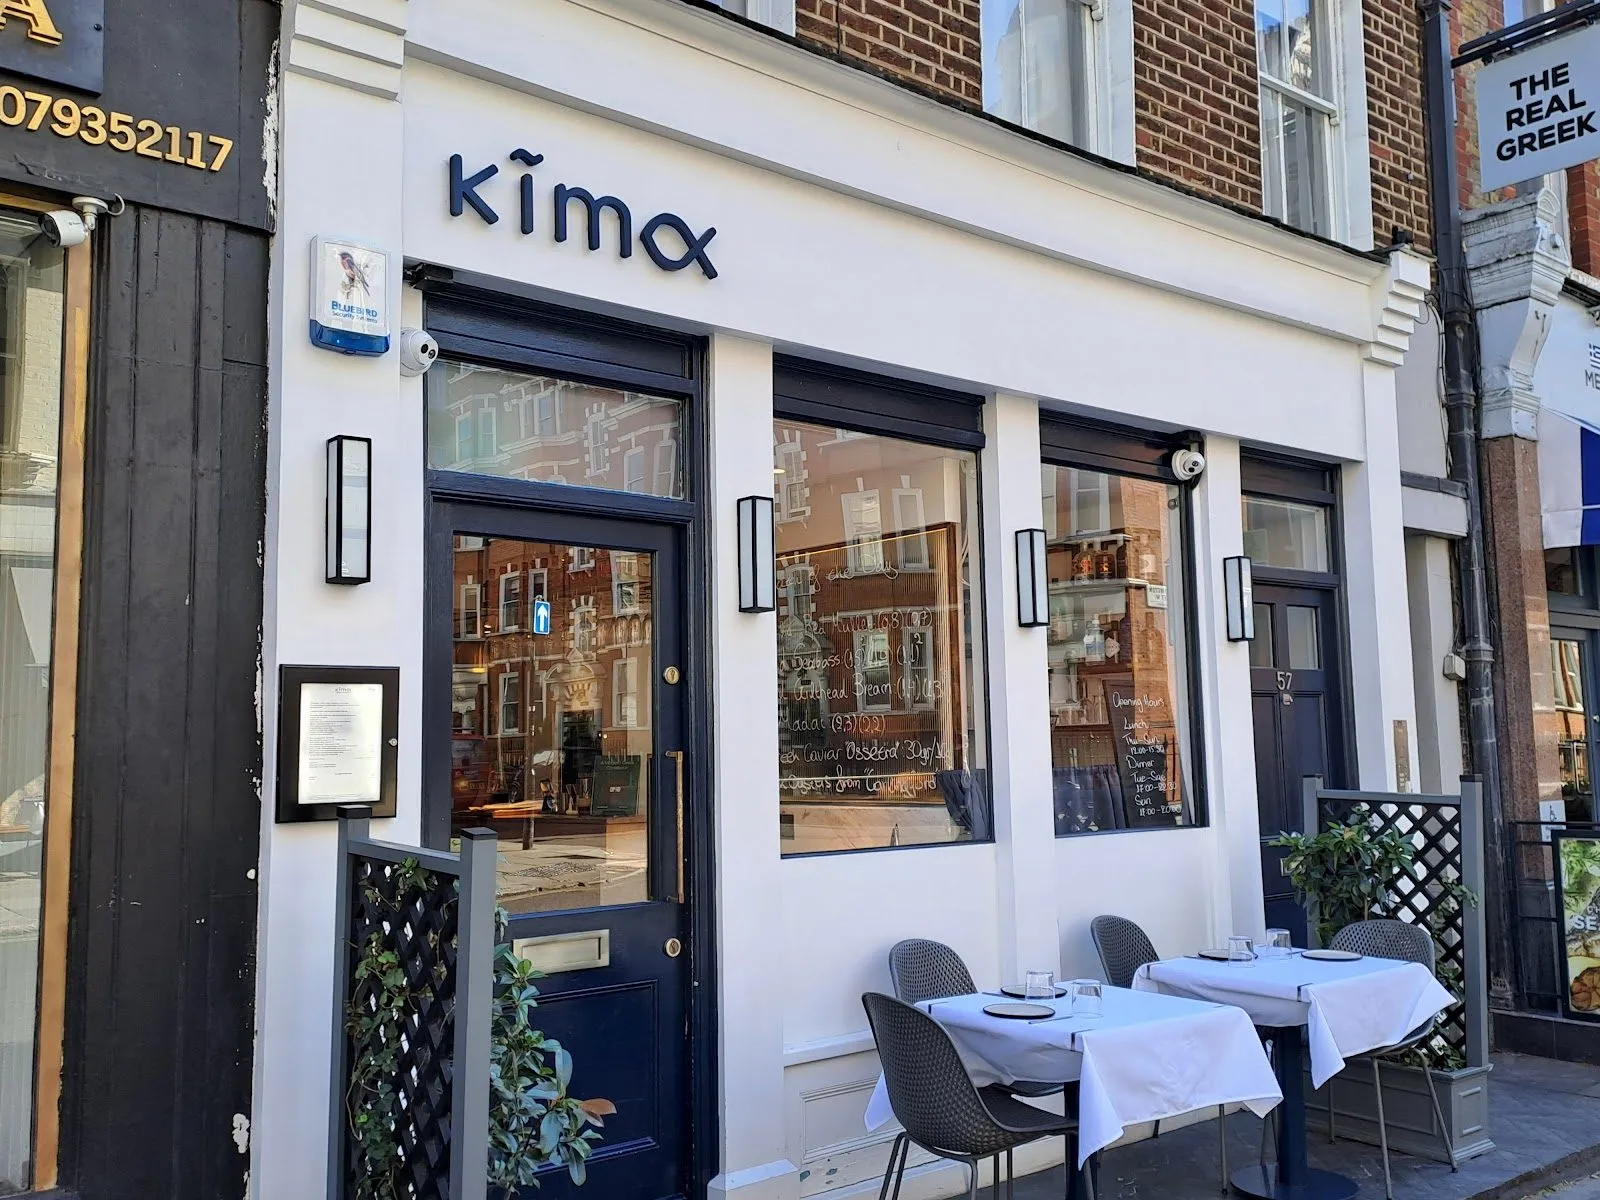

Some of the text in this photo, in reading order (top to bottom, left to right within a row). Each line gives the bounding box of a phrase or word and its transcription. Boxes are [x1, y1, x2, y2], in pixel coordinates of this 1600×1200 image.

[1509, 62, 1570, 101] THE
[1506, 88, 1587, 132] REAL
[0, 85, 234, 172] 079352117
[1496, 110, 1599, 162] GREEK
[331, 300, 378, 318] BLUEBIRD
[1276, 670, 1293, 691] 57
[1112, 691, 1165, 713] Opening Hours
[1123, 716, 1149, 730] Lunch
[803, 742, 843, 763] Caviar
